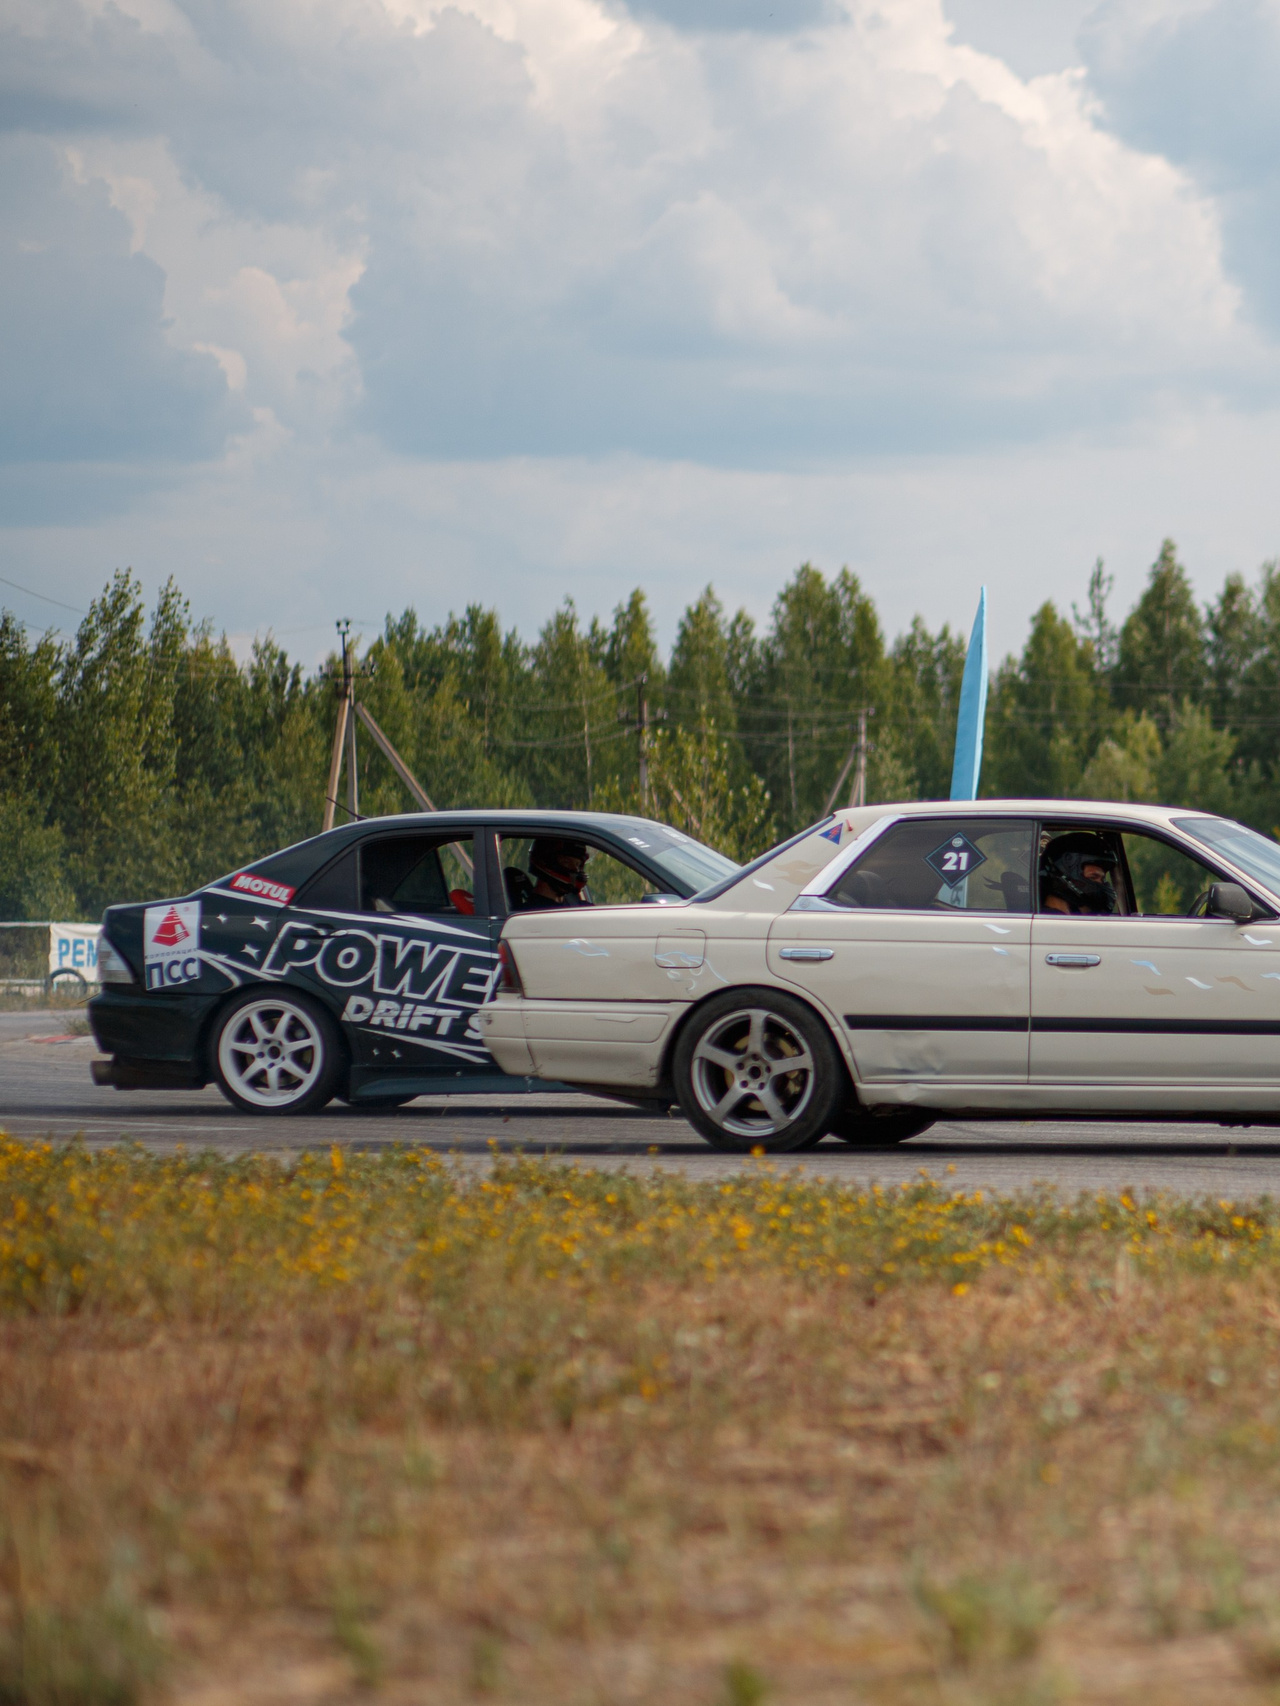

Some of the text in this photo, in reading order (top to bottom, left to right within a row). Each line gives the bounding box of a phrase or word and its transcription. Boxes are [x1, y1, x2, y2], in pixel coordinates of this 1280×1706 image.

[941, 851, 969, 871] 21
[233, 875, 290, 902] MOTUL
[145, 957, 197, 989] ПСС
[341, 995, 462, 1036] DRIFT
